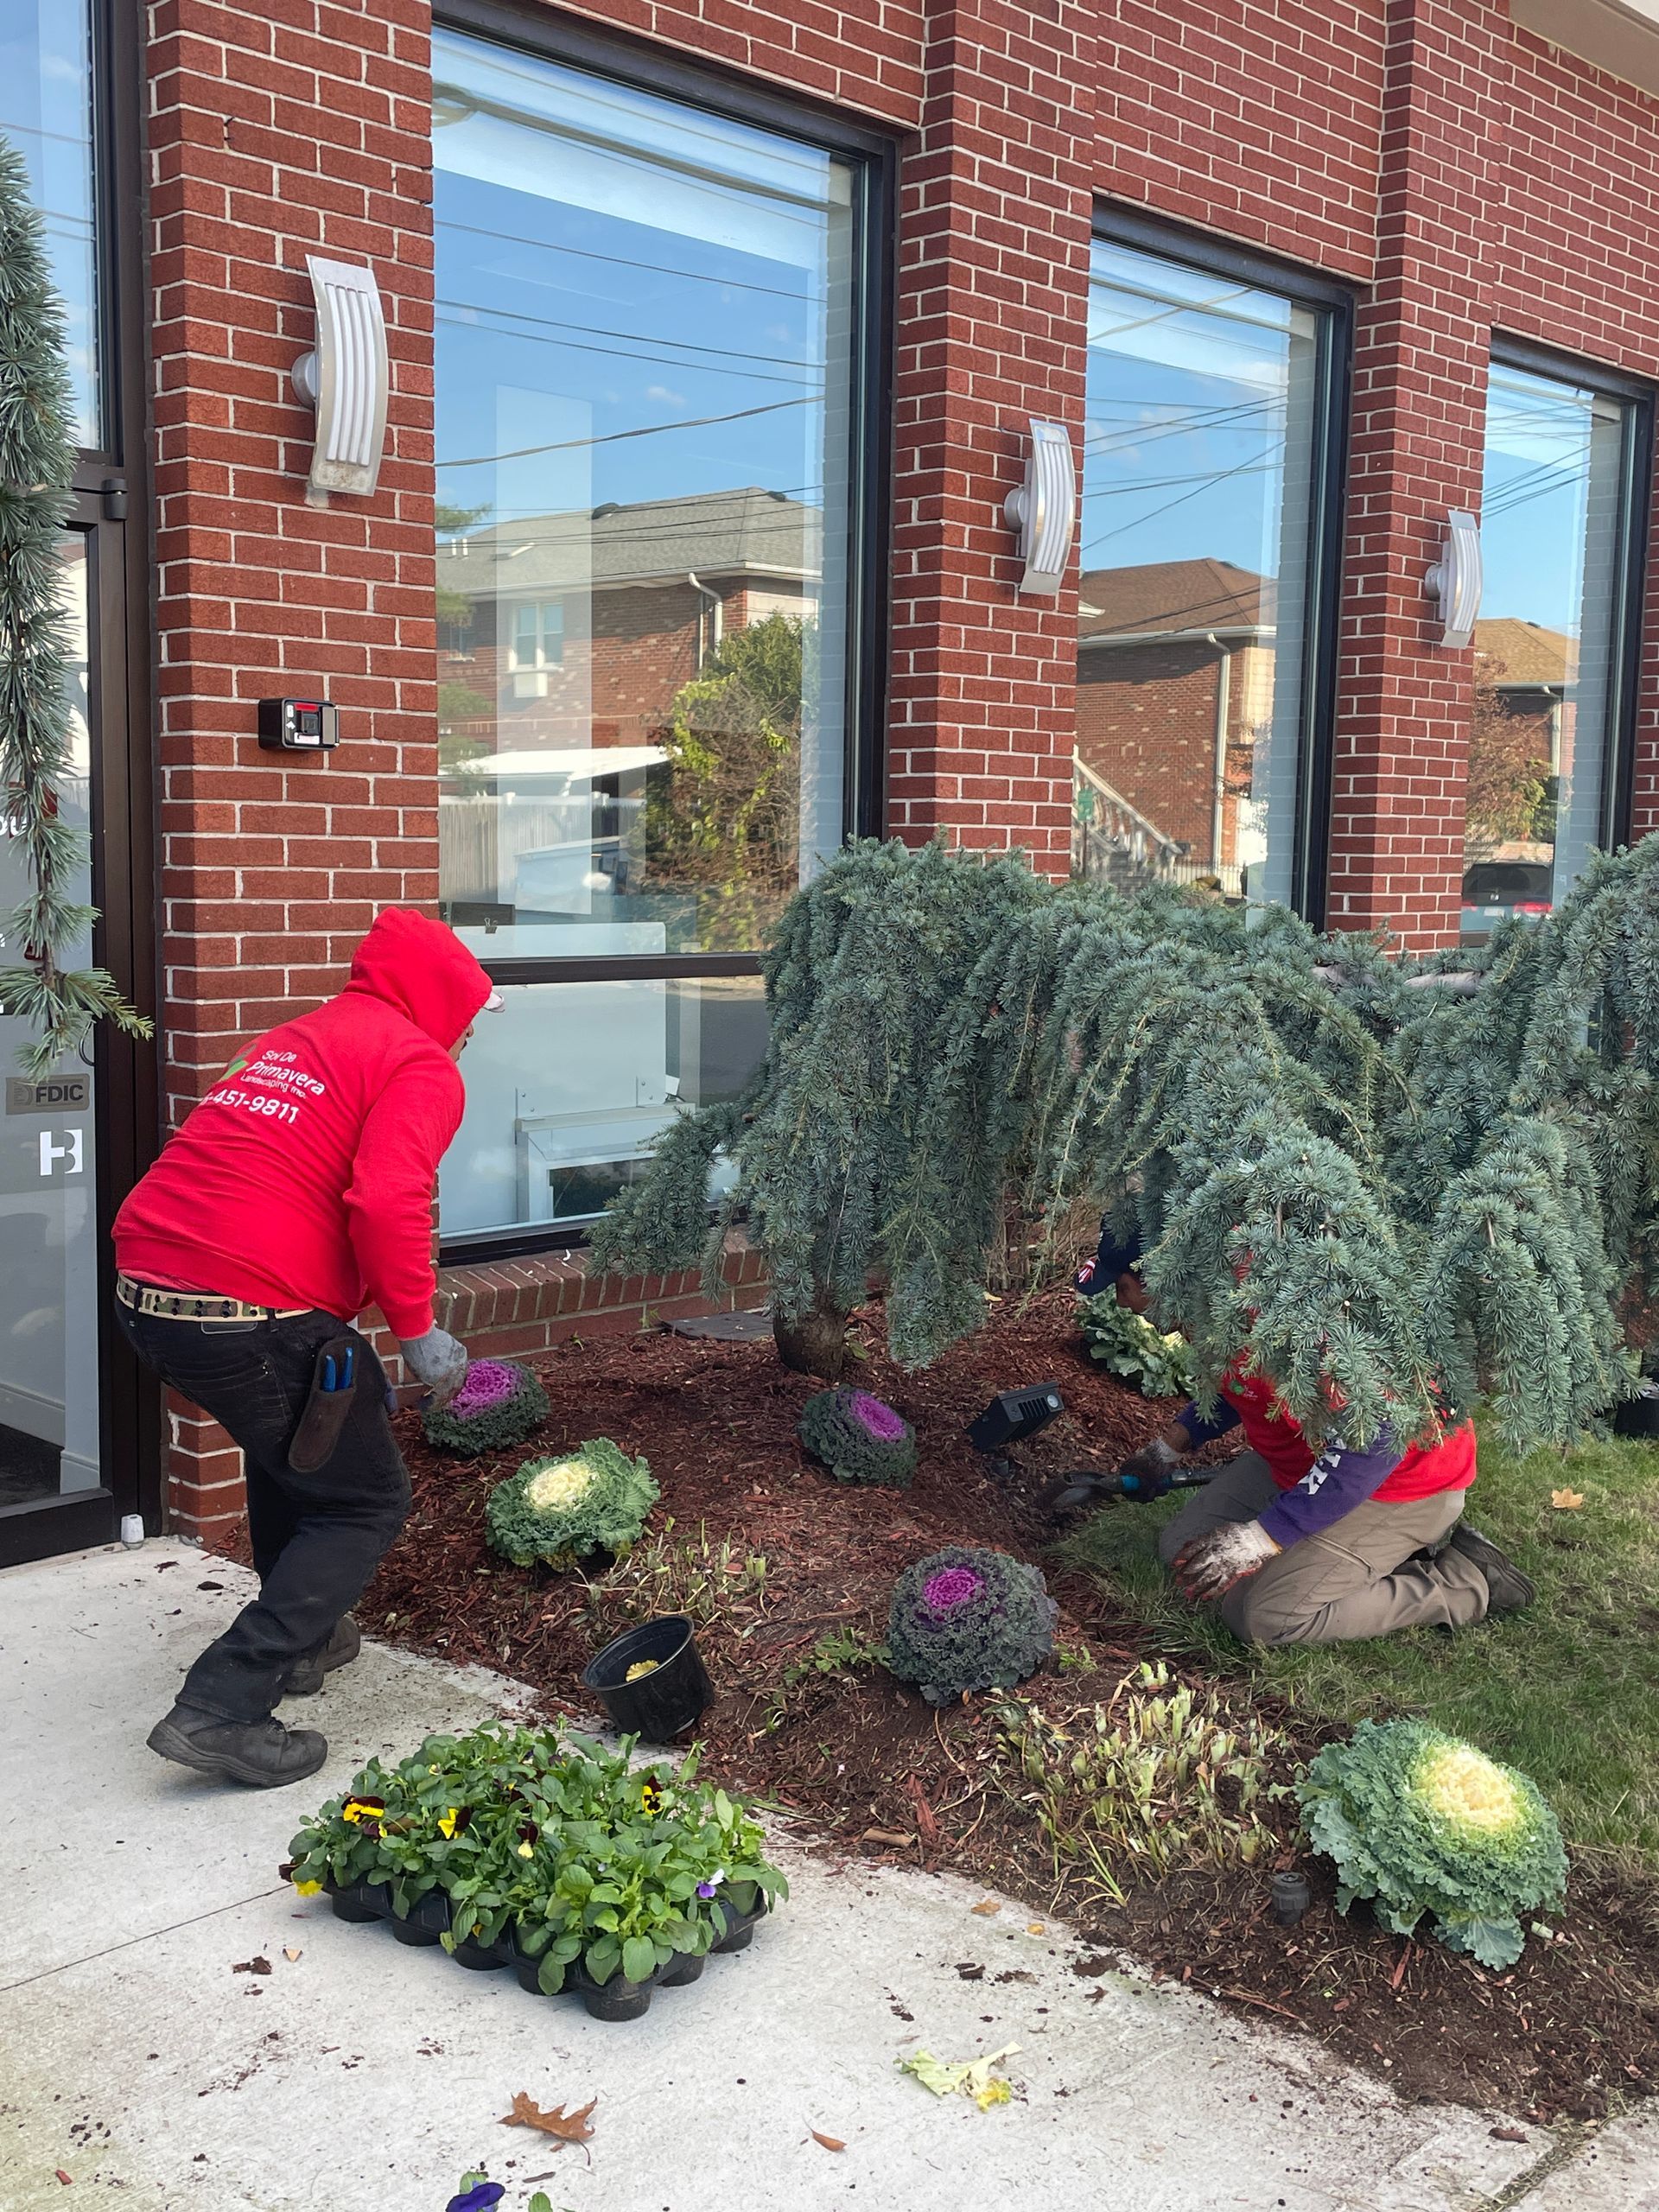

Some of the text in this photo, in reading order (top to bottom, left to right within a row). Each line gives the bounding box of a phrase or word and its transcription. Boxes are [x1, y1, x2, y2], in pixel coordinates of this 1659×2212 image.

[262, 1050, 297, 1063] Sol De
[240, 1073, 289, 1093] Landscaping
[245, 1060, 326, 1096] Primavera
[35, 1084, 85, 1103] FDIC
